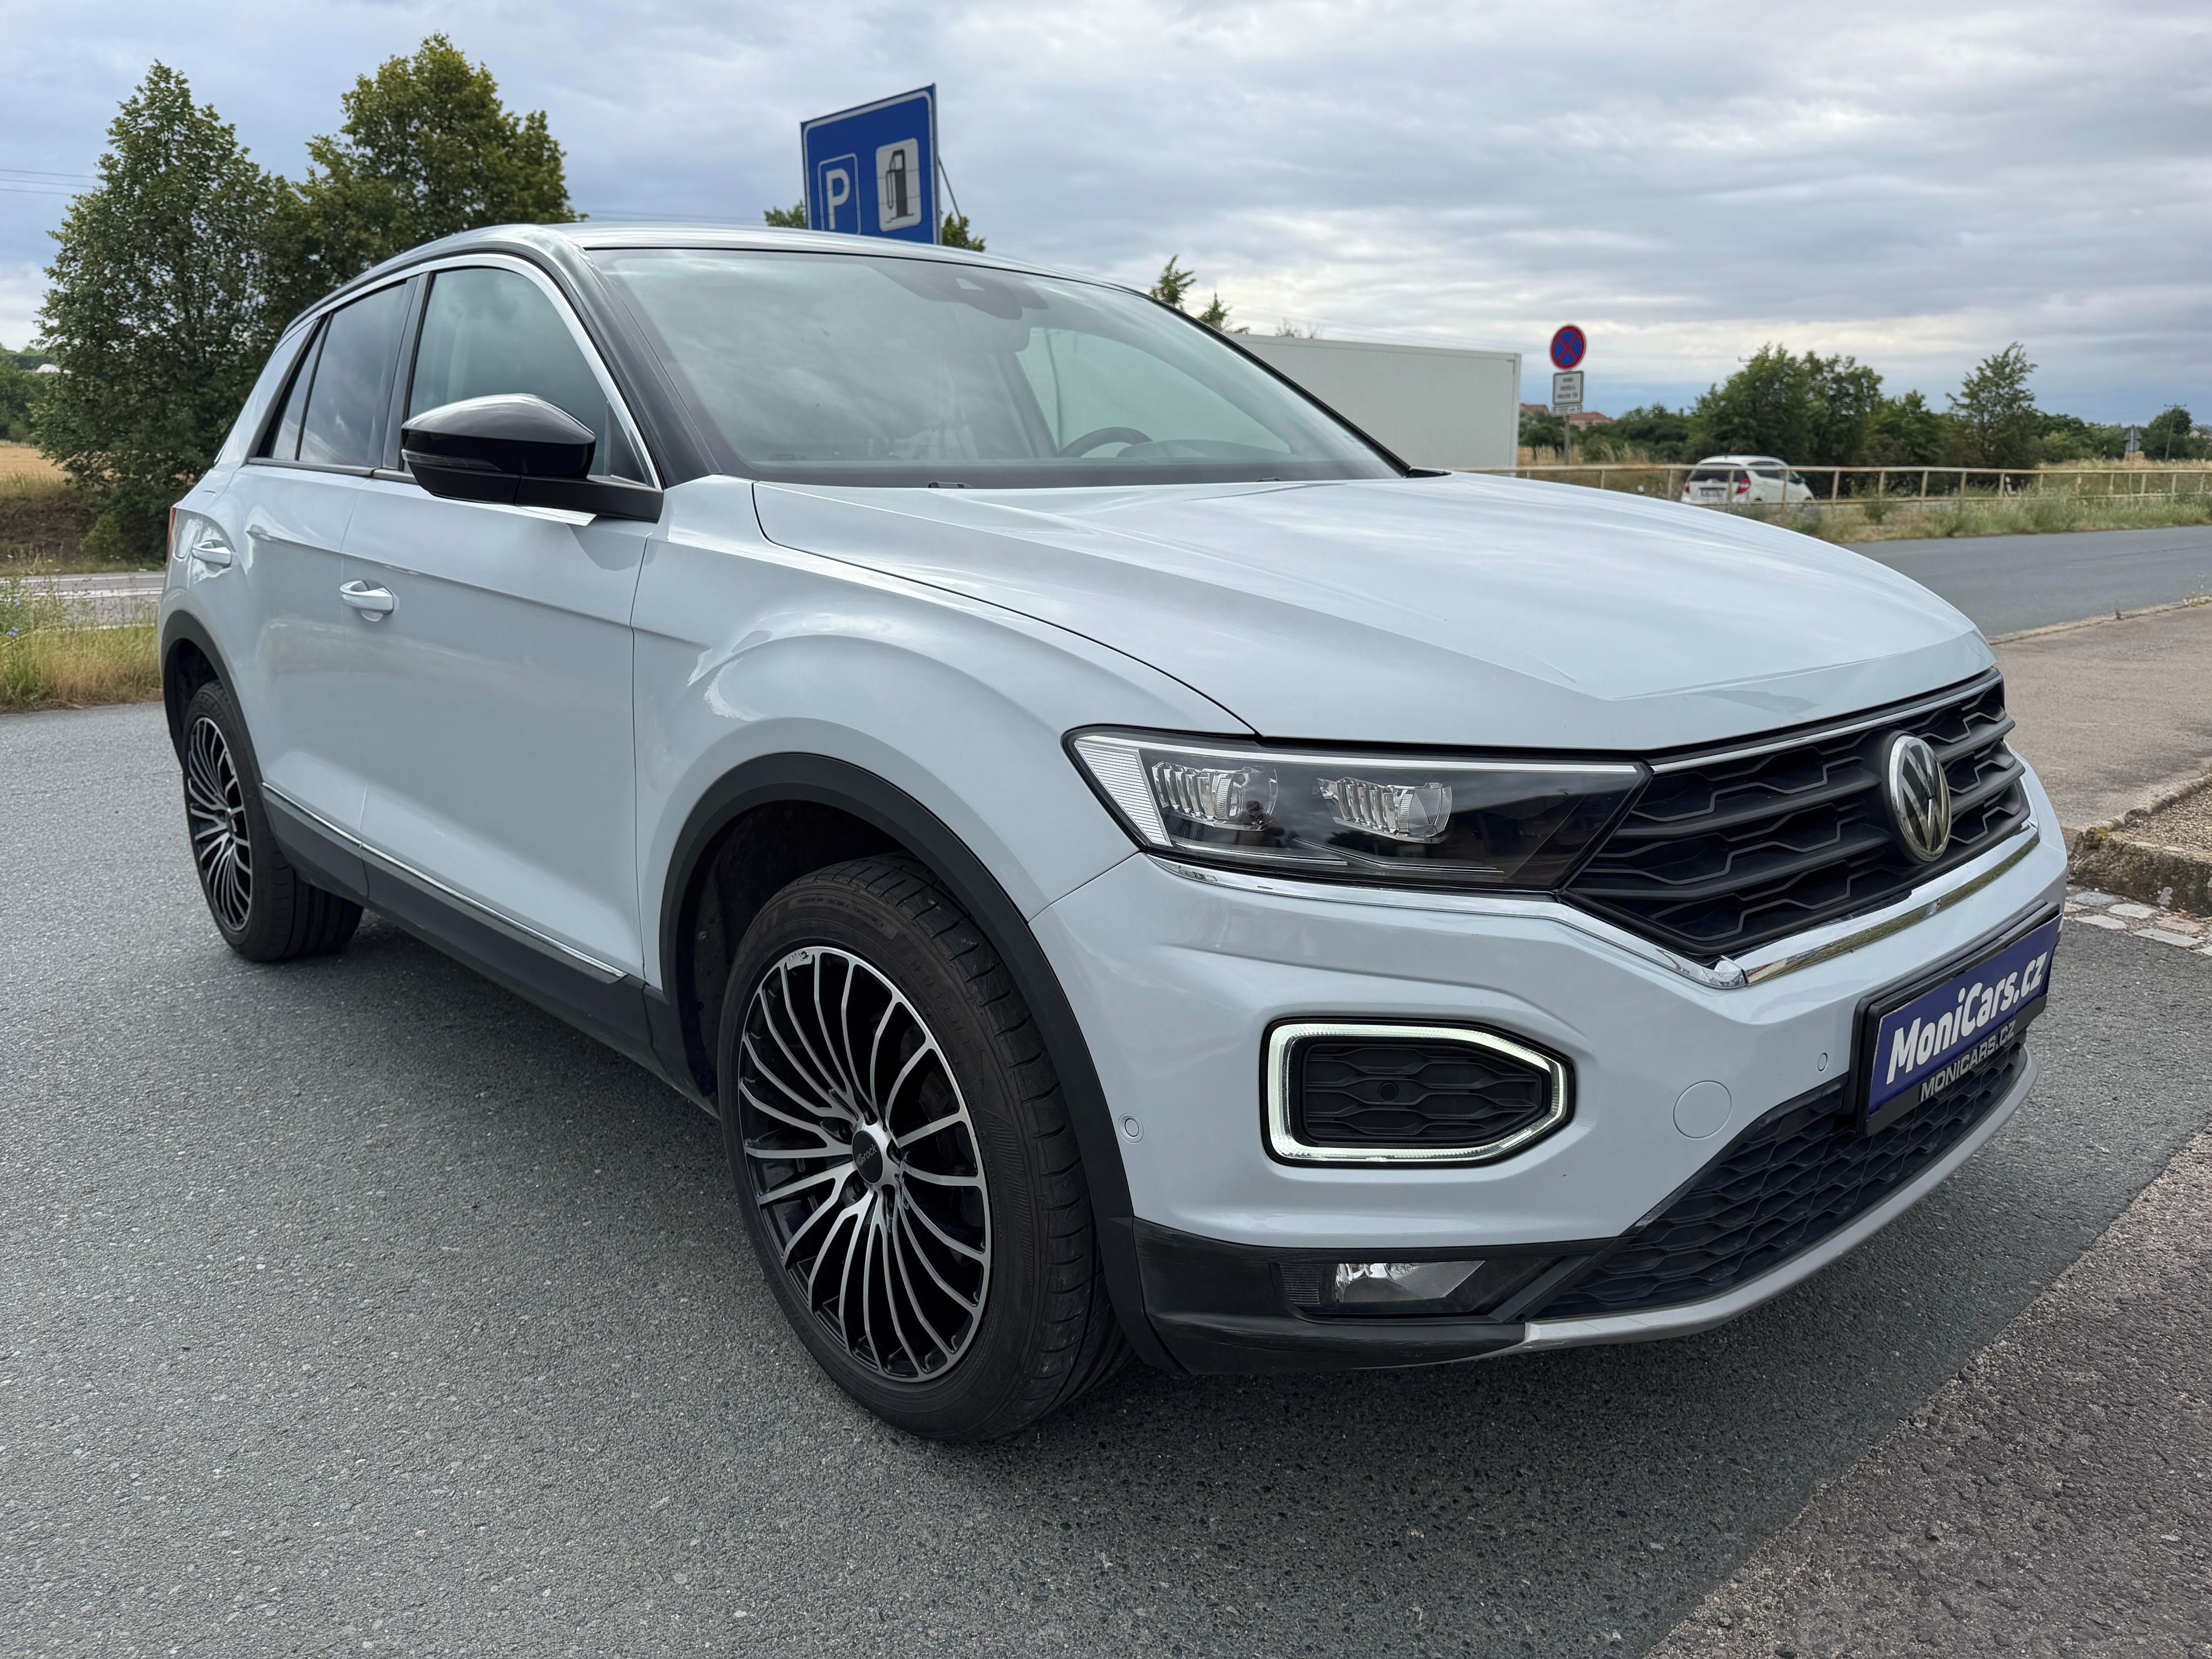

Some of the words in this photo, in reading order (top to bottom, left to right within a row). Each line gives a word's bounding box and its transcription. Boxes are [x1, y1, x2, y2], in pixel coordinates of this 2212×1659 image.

[826, 168, 850, 230] P
[1886, 951, 2048, 1085] MoniCars.cz
[1920, 1020, 2017, 1102] MONICARS.CZ
